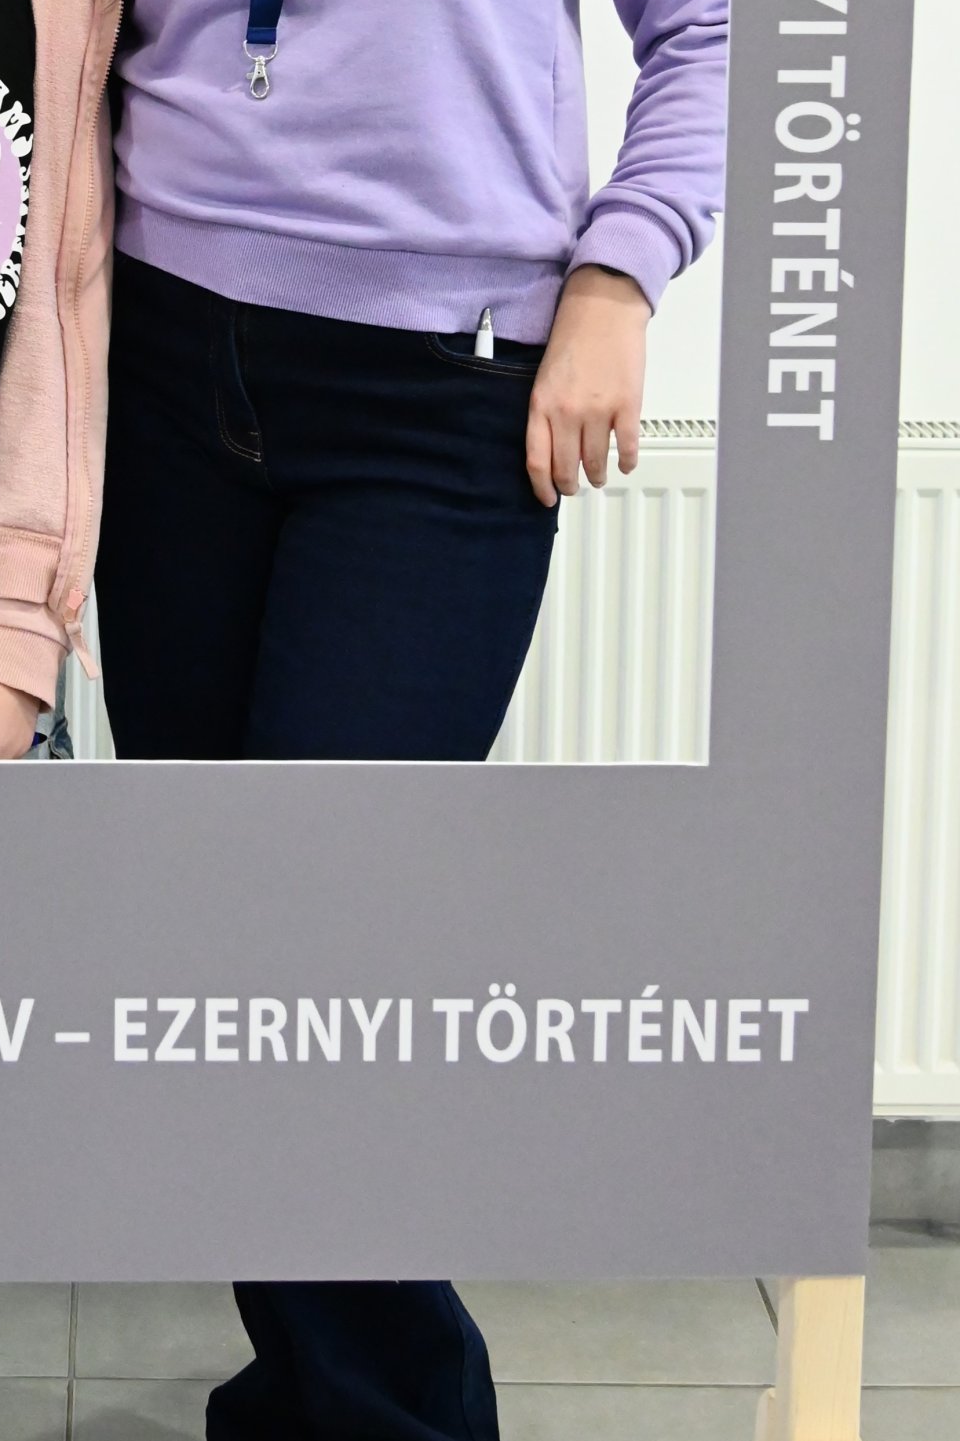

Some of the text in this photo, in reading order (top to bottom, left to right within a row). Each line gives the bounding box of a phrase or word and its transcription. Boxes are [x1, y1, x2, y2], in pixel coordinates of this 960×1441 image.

[766, 55, 862, 441] TÖRTÉNET
[114, 997, 413, 1062] EZERNYI
[433, 982, 810, 1063] TÖRTÉNET
